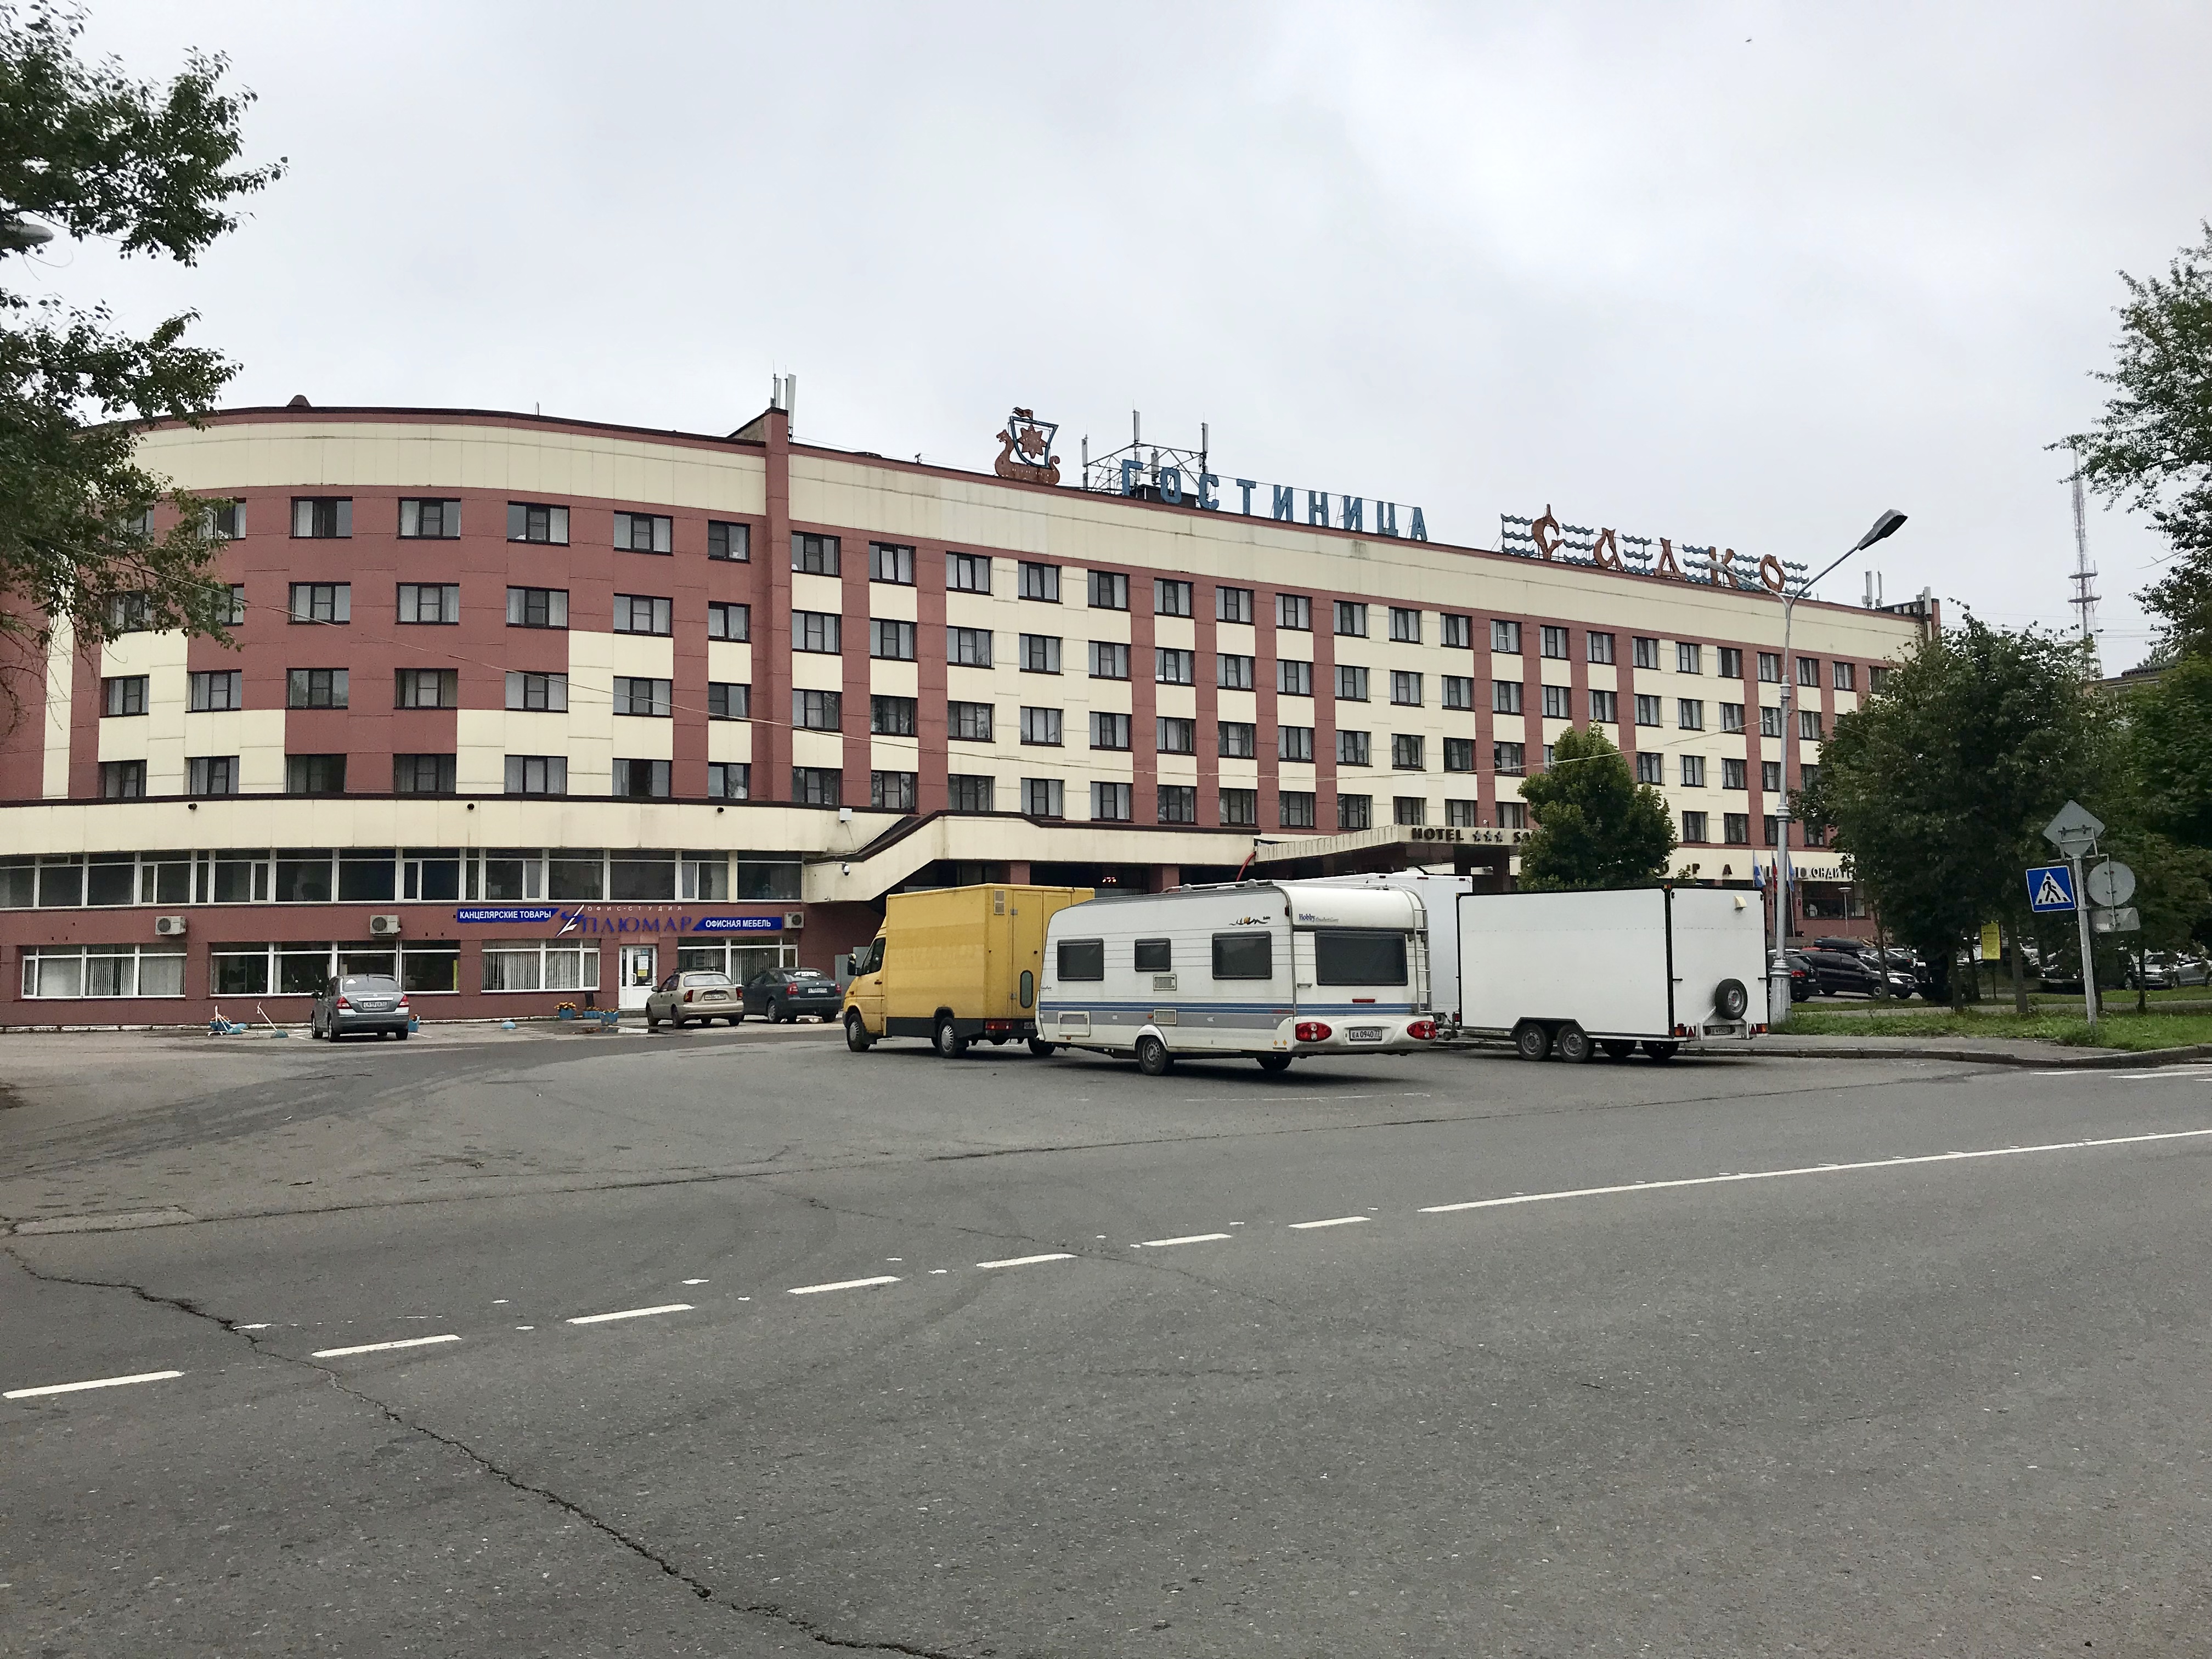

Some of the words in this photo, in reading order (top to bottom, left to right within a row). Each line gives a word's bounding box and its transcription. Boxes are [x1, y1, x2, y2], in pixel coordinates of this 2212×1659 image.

[1122, 459, 1428, 541] ГОСТИНИЦА
[1531, 503, 1785, 593] САДКО
[1411, 827, 1464, 841] HOTEL
[460, 911, 518, 919] КАНЦЕЛЯРСКИЕ
[1299, 913, 1316, 923] Hobby
[706, 919, 741, 928] ОФИСНАЯ
